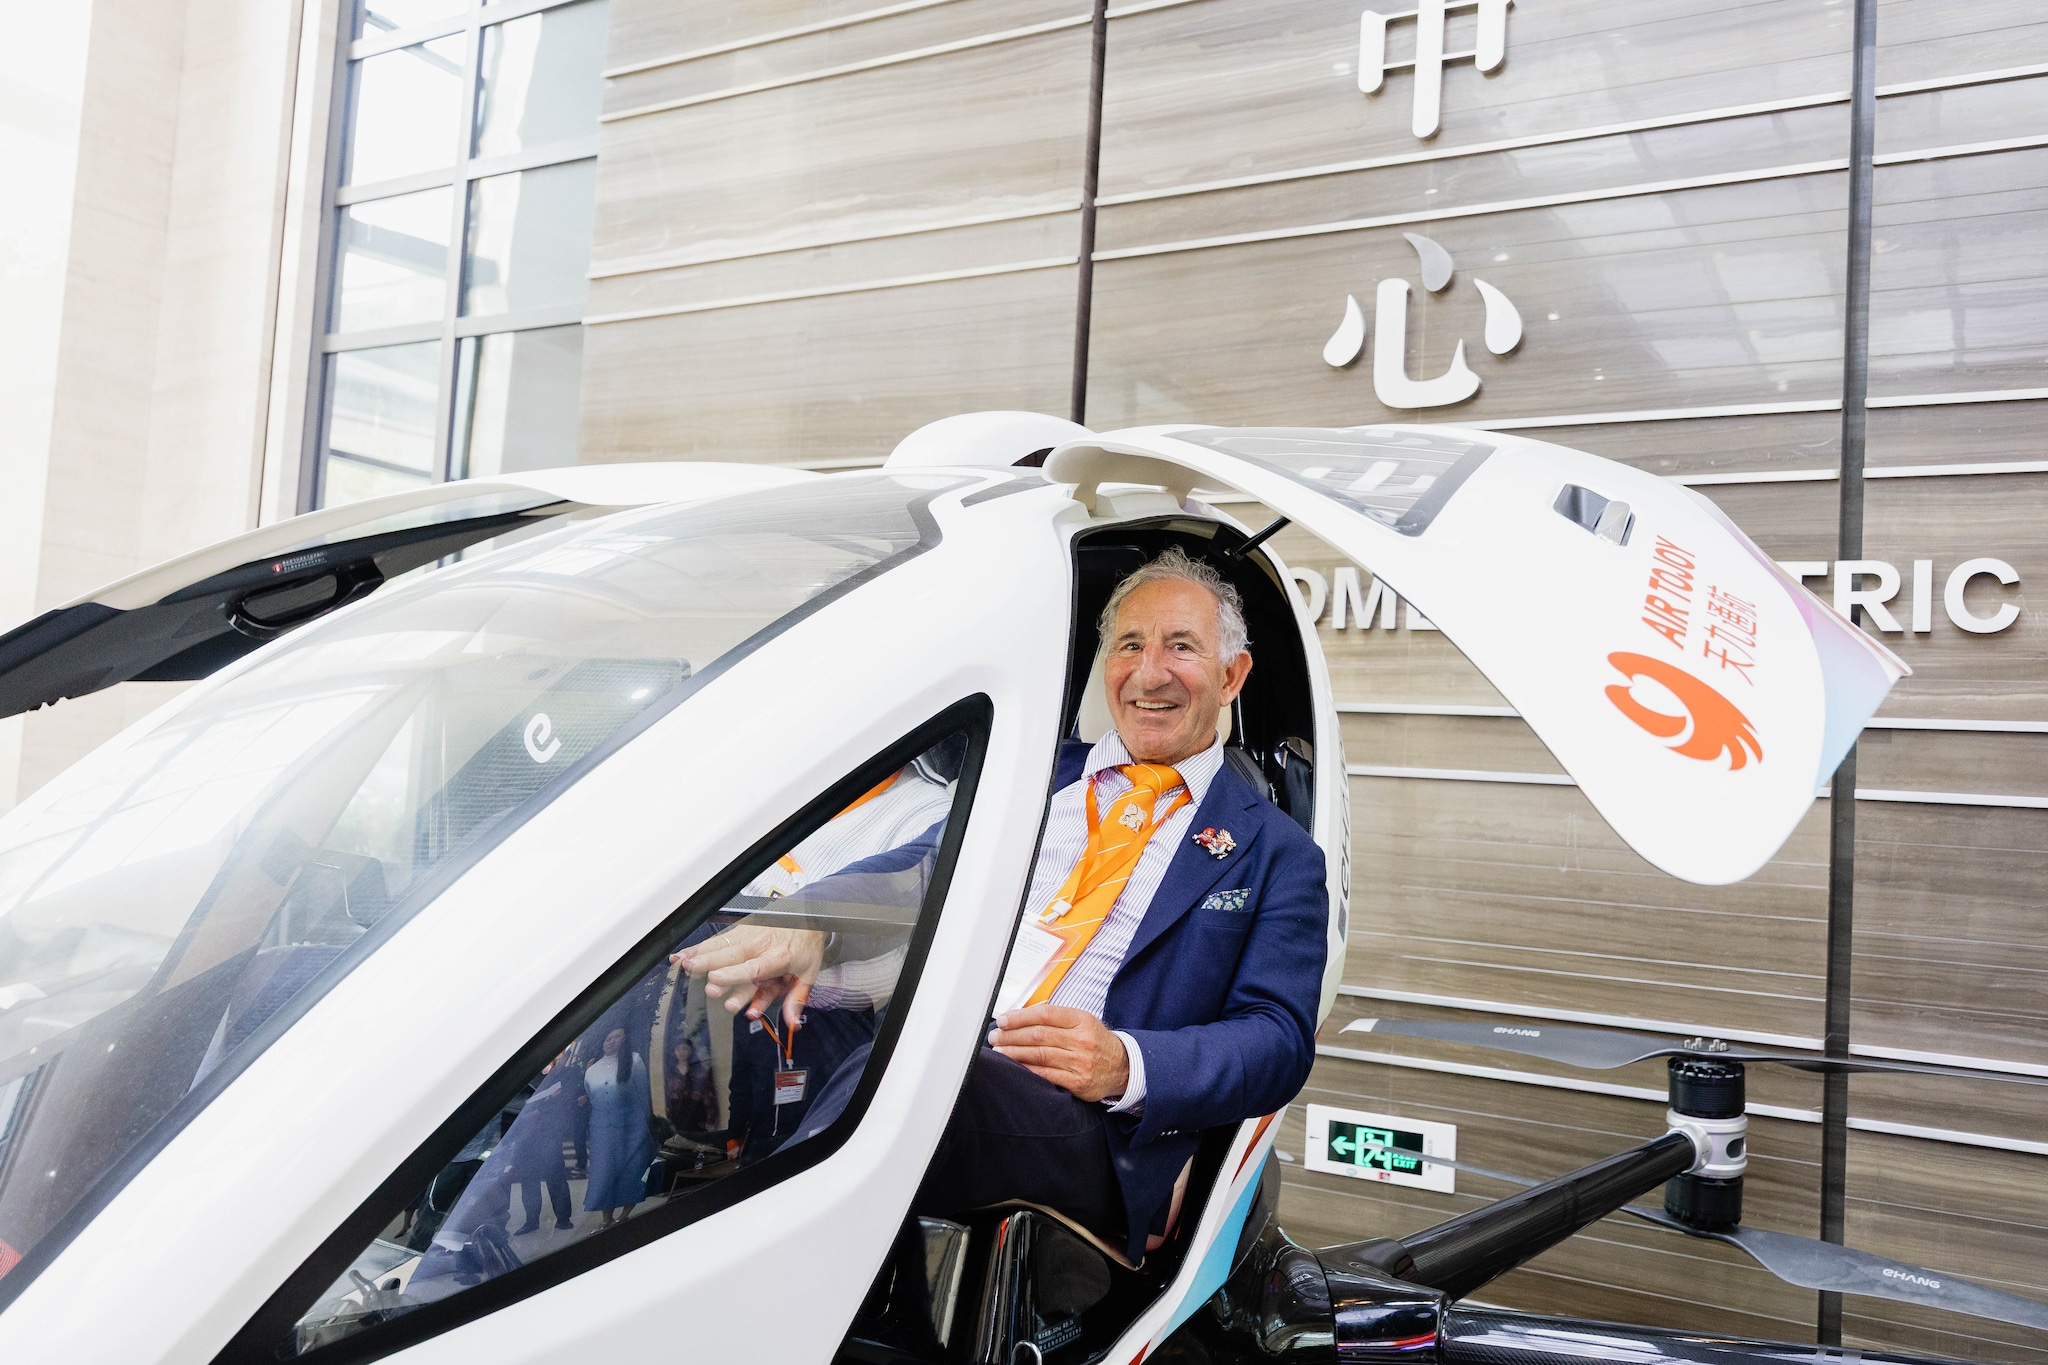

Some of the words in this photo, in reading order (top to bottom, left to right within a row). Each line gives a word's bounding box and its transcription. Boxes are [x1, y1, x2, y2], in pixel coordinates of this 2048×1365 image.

[1648, 534, 1696, 603] TOJOY
[1641, 593, 1690, 651] AIR
[1703, 584, 1758, 687] 天九通航
[1393, 1158, 1418, 1170] EXIT
